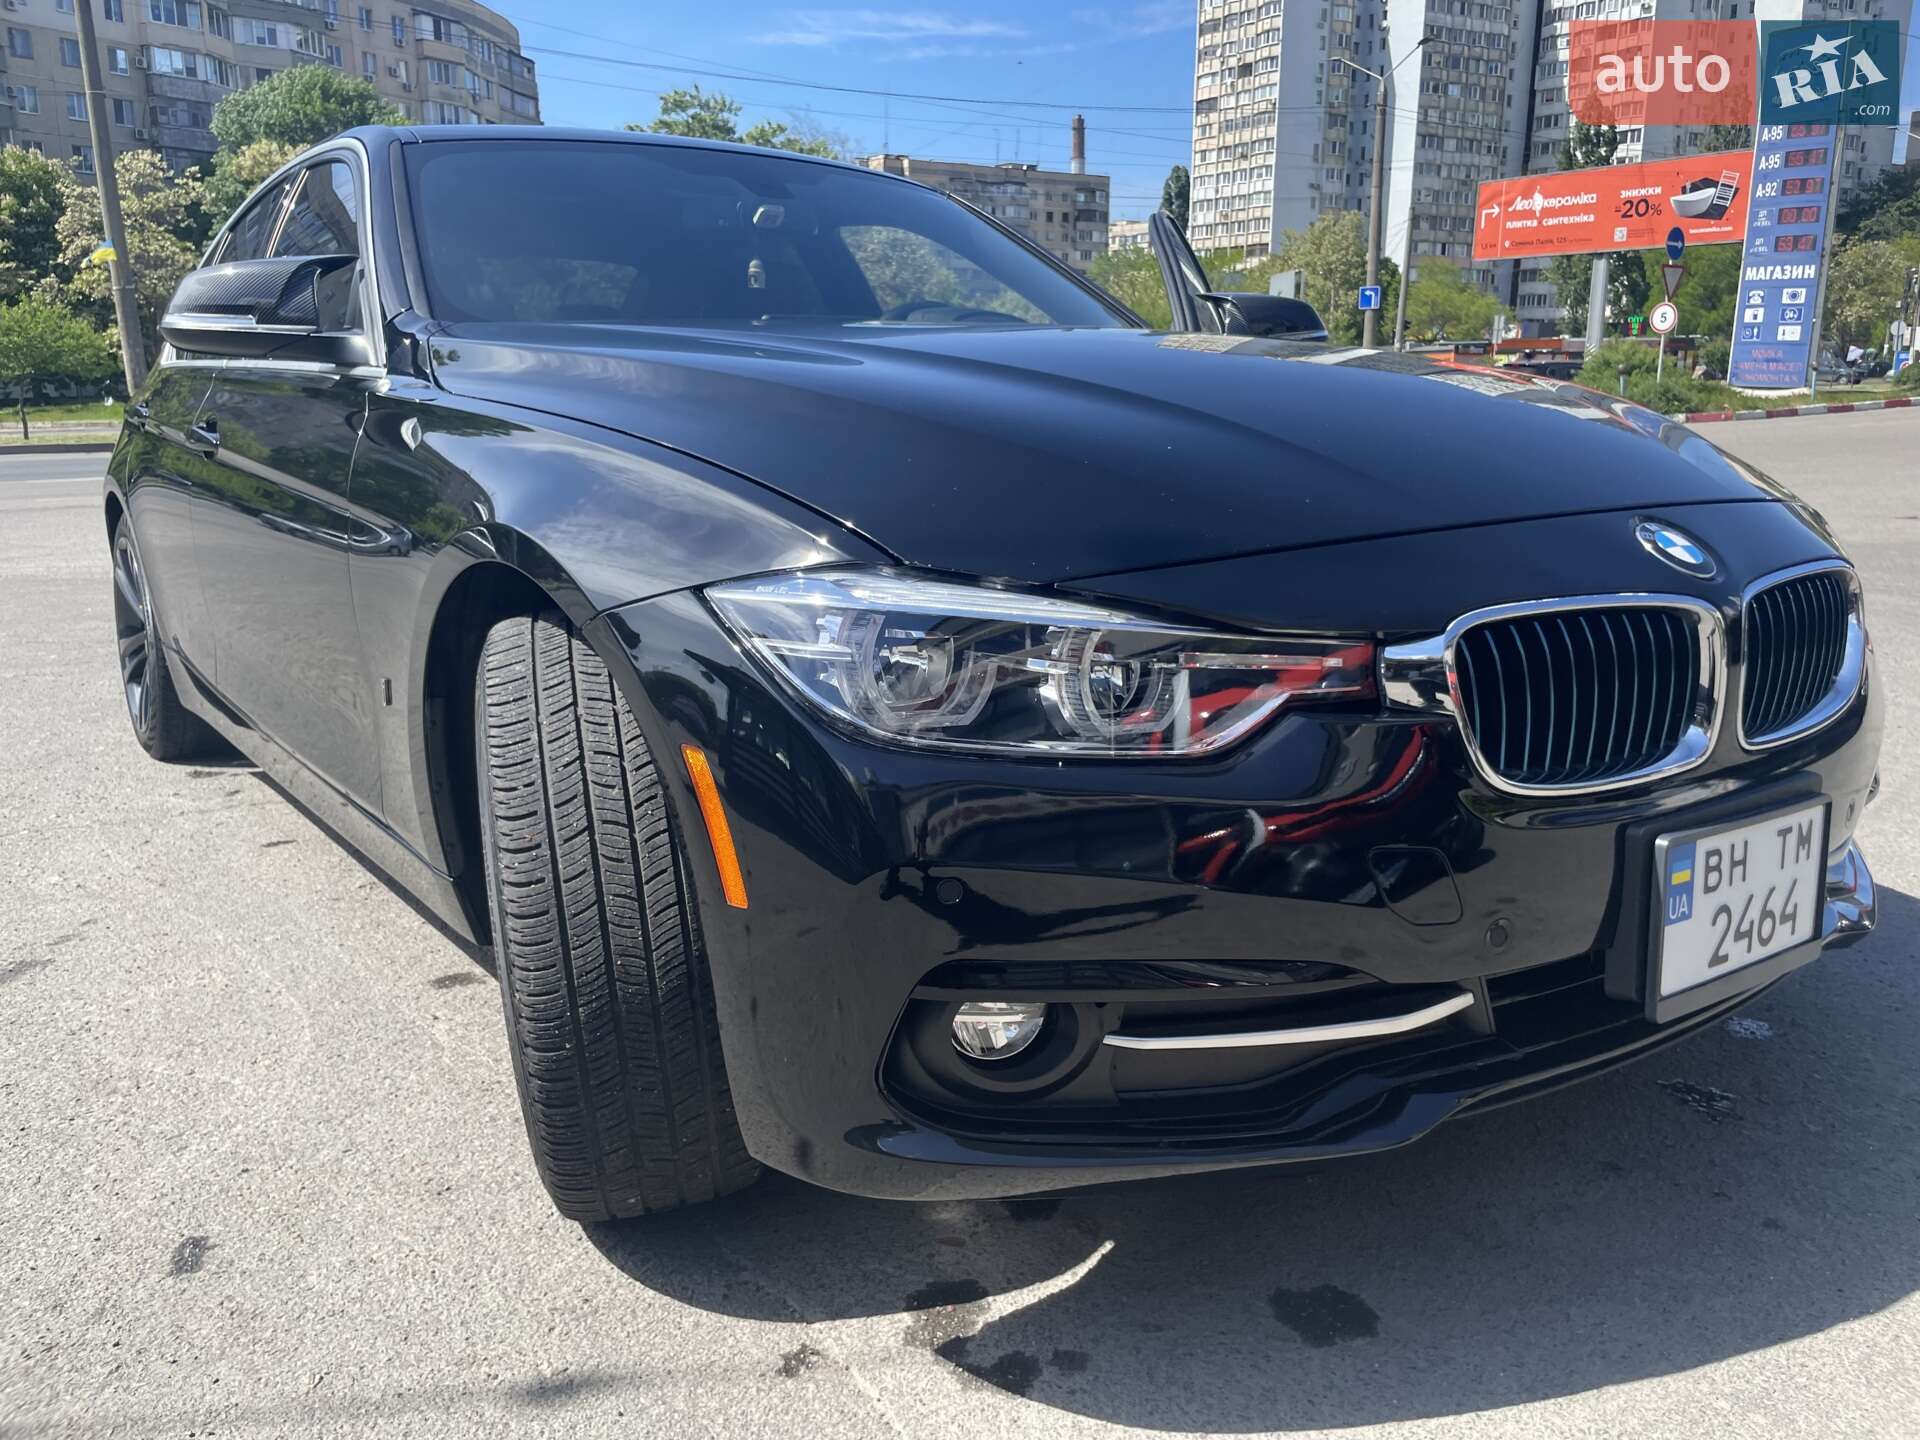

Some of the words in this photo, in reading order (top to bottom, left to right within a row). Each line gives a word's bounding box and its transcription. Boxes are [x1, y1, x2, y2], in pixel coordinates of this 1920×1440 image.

[1745, 264, 1816, 281] МАГАЗИН
[1659, 312, 1667, 323] 5
[1703, 839, 1748, 895] BH
[1776, 819, 1813, 870] TM
[1669, 893, 1689, 920] UA
[1708, 878, 1798, 969] 2464
